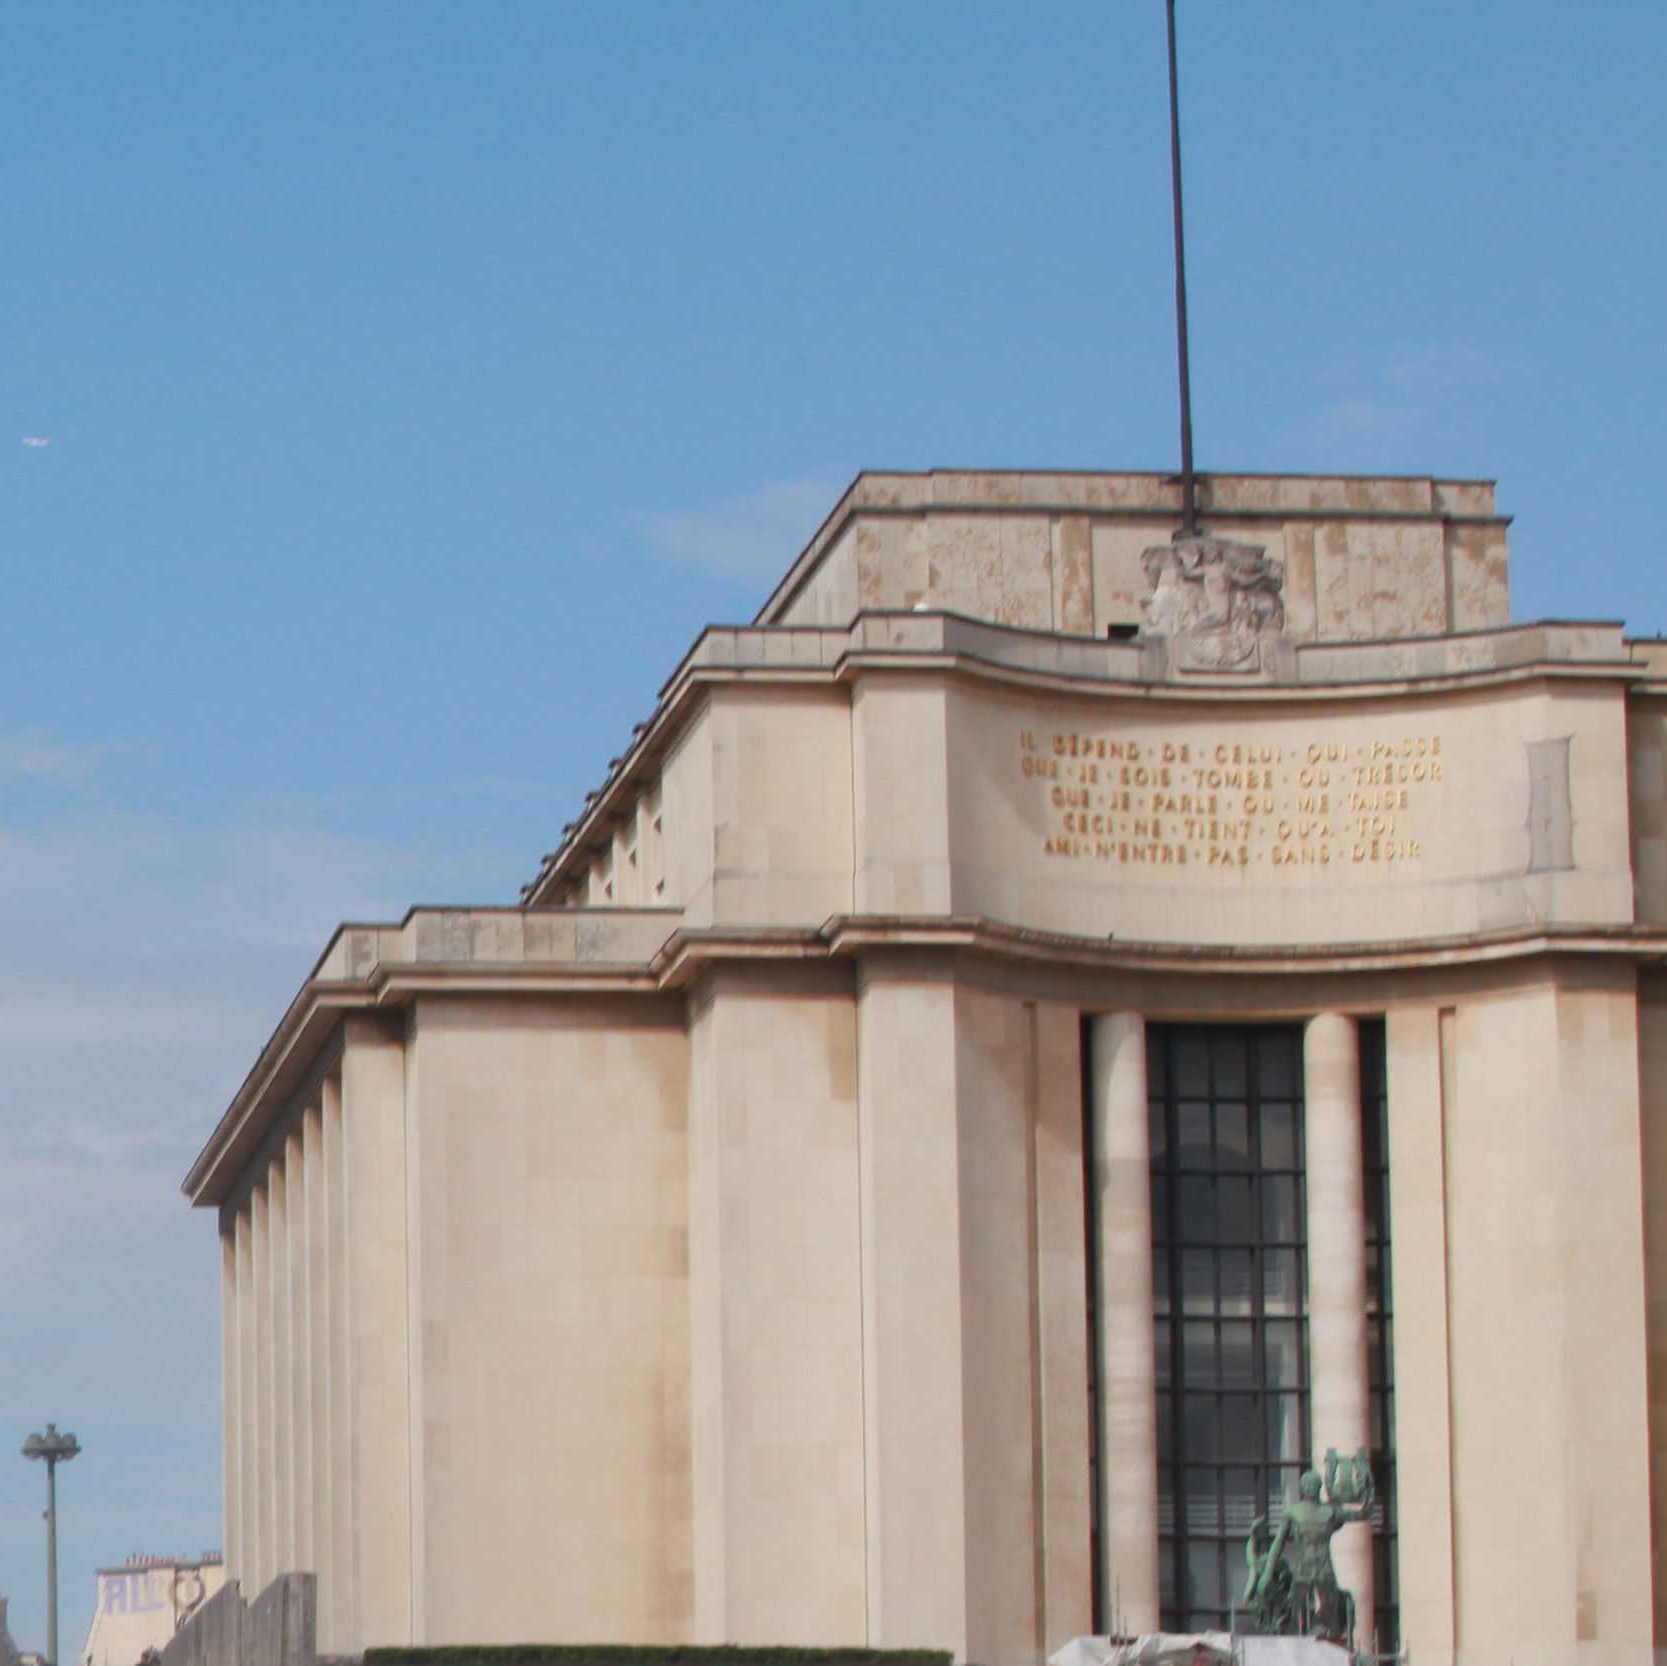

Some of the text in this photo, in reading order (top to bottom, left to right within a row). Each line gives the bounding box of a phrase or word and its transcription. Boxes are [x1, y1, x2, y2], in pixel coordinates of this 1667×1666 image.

[1020, 731, 1441, 765] IL DÉPEND DE CELUI QUI PASSE
[1021, 756, 1441, 790] QUE JE SOIS TOMBE OU TRÉSOR
[1051, 784, 1408, 815] QUE JE PARLE OU ME TAISE
[1062, 812, 1114, 835] CECI
[1134, 818, 1160, 839] NE
[1185, 819, 1251, 840] TIENT
[1356, 816, 1395, 838] TOI
[1044, 836, 1420, 866] AMI N'ENTRE PAS SANS DÉSIR
